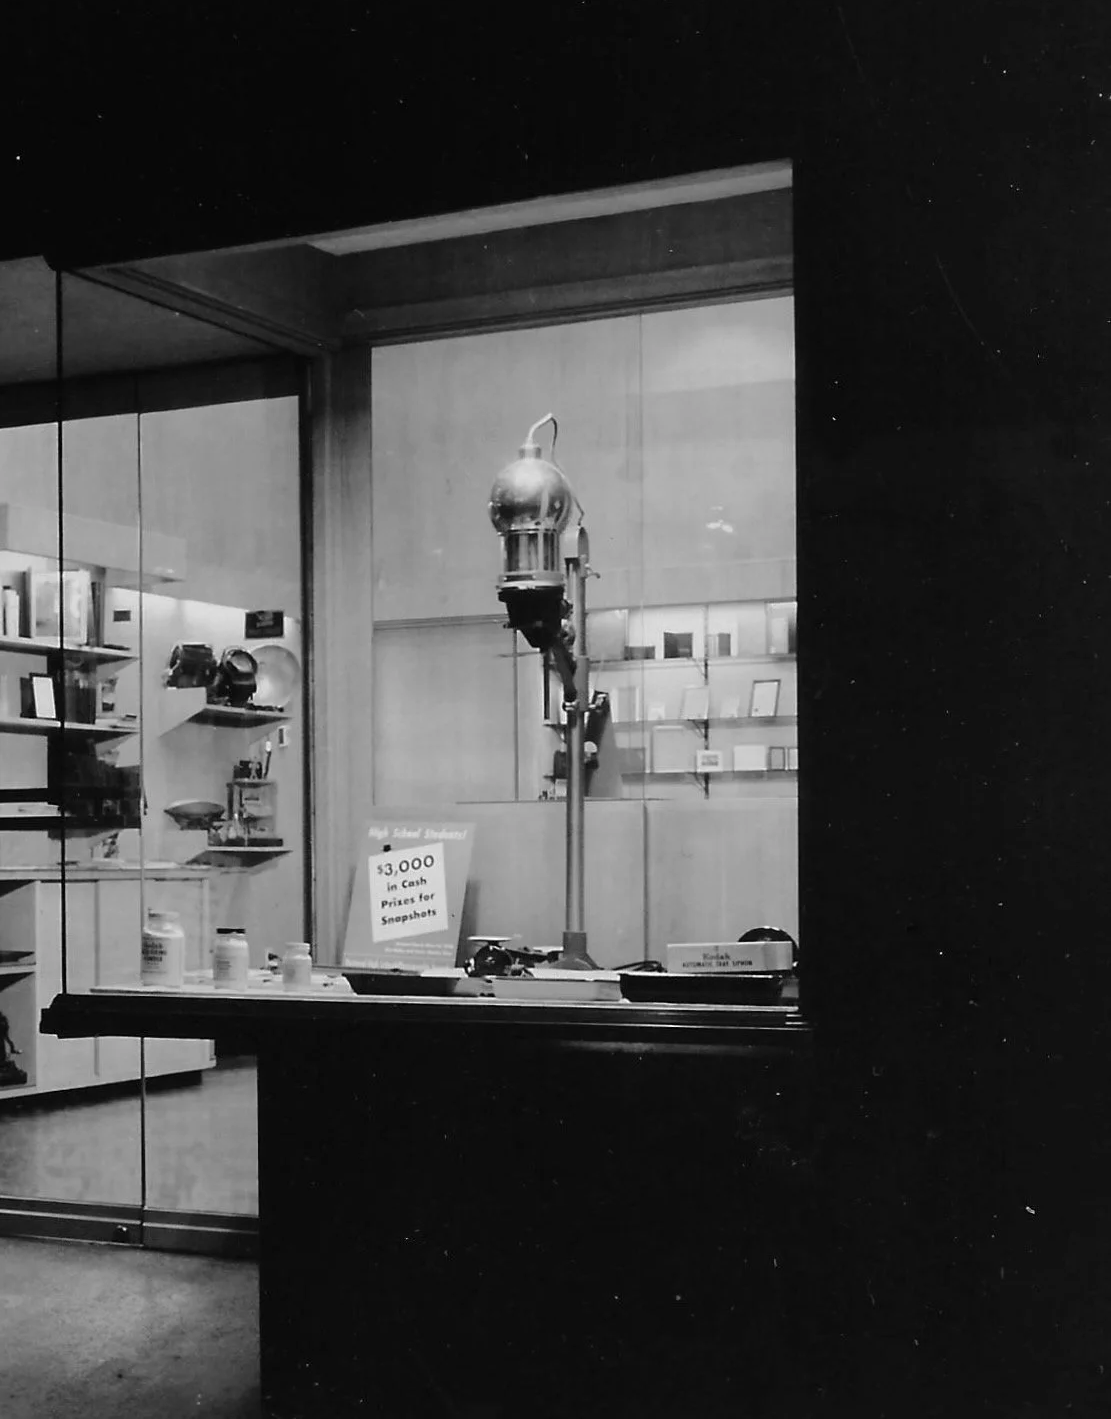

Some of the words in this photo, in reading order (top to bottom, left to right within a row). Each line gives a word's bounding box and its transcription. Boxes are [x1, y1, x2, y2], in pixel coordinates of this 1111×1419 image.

[391, 827, 422, 839] School
[377, 854, 435, 877] $3,000
[387, 881, 398, 892] in
[401, 876, 427, 889] Cash
[381, 896, 415, 909] Prizes
[419, 892, 435, 902] for
[381, 908, 437, 926] Snapshots
